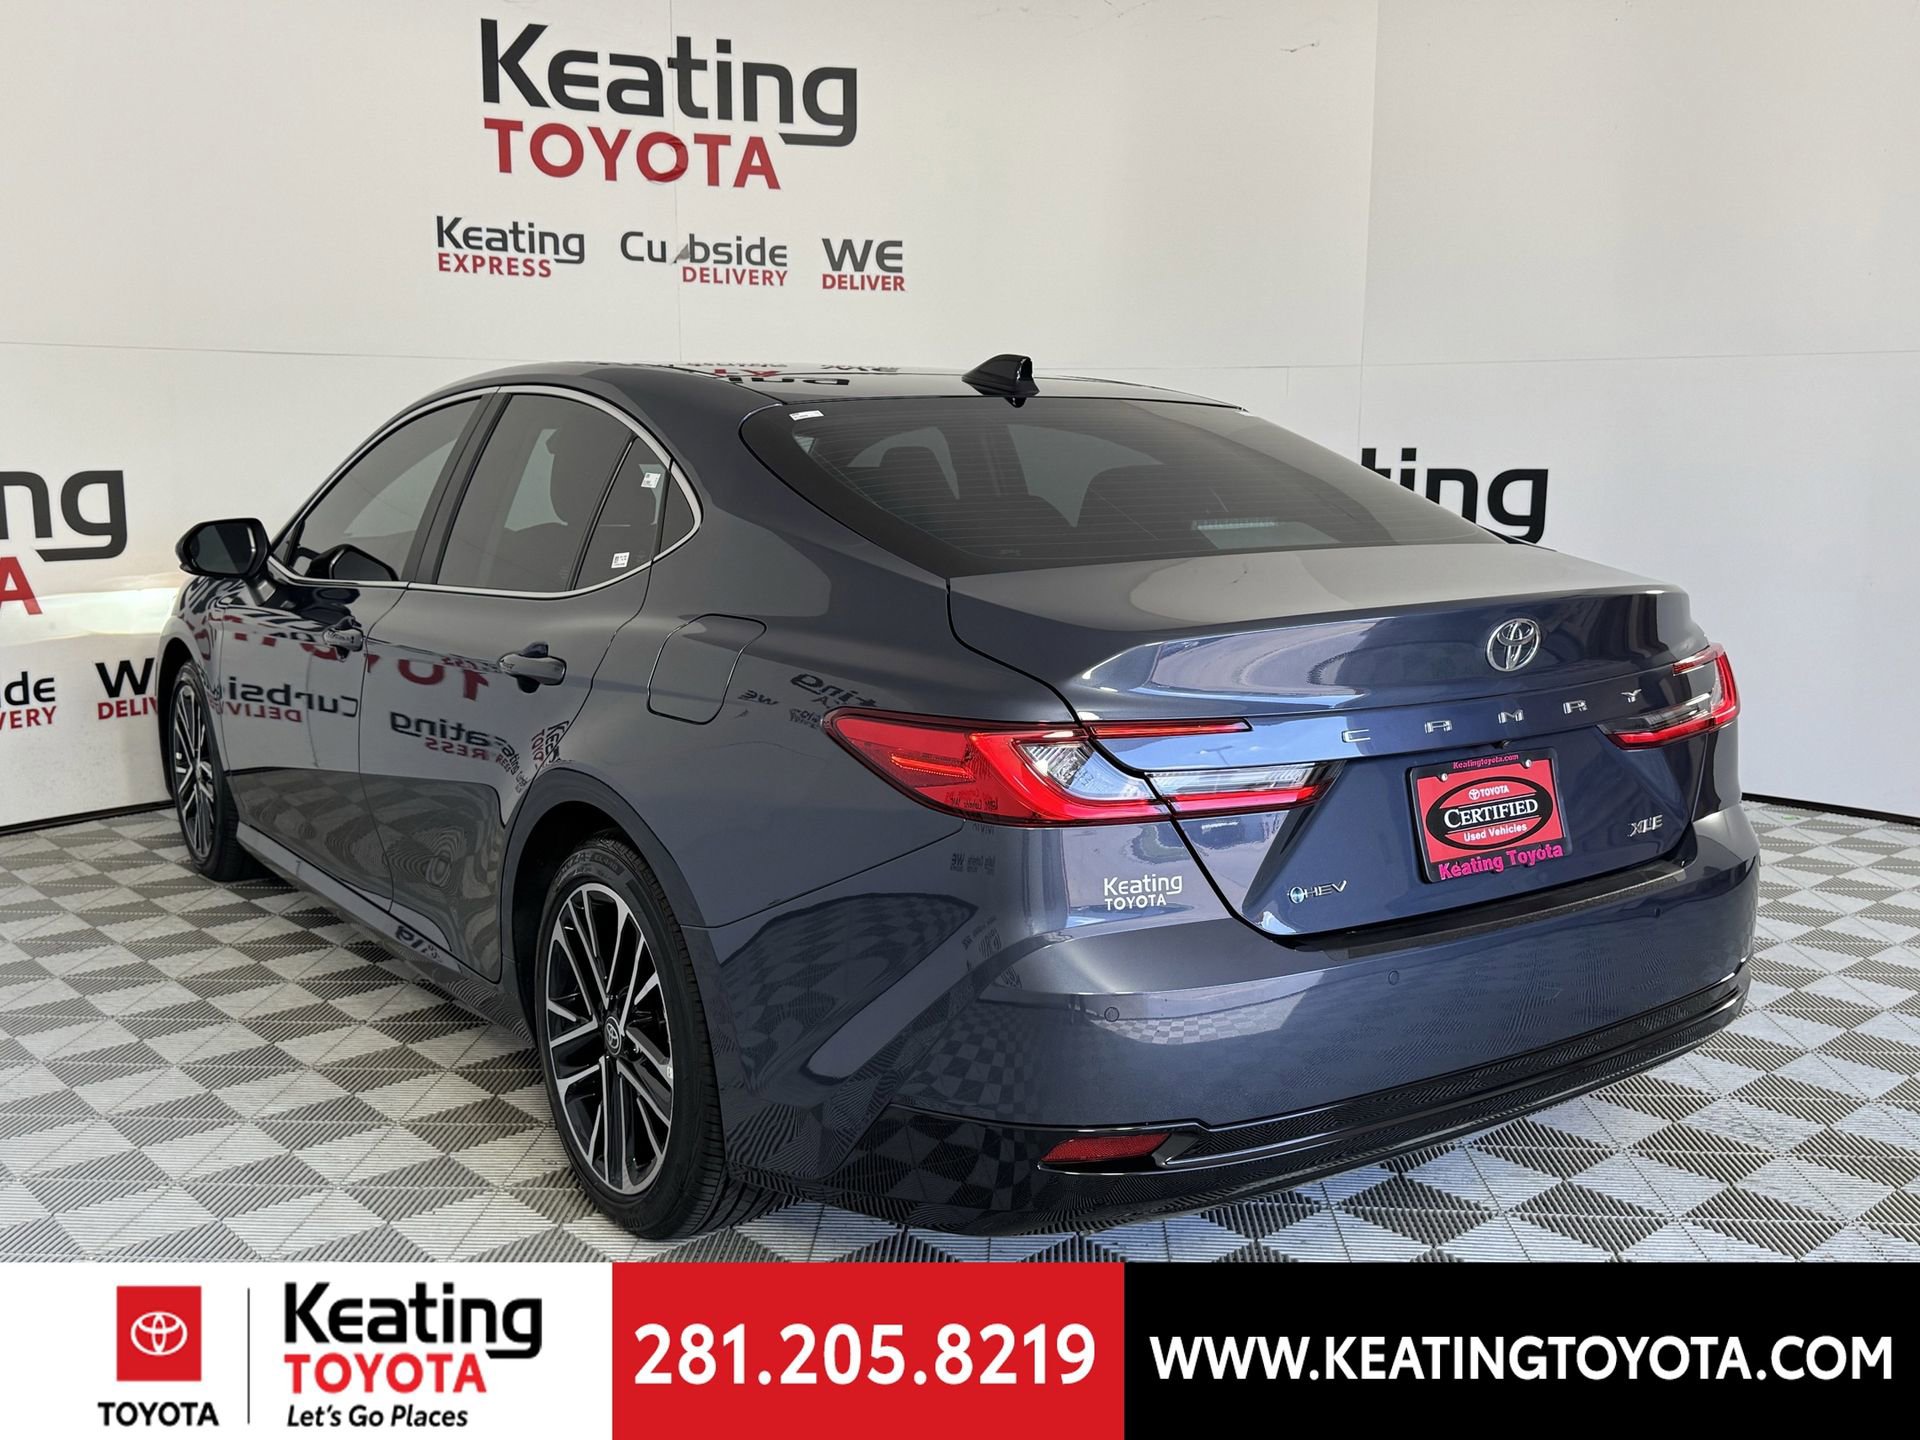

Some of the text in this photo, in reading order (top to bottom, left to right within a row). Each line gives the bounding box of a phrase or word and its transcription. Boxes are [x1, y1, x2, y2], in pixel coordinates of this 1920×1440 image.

[480, 18, 857, 147] Keating
[484, 117, 781, 190] TOYOTA
[436, 215, 585, 264] Keating
[620, 231, 788, 267] Cubside
[438, 252, 552, 278] EXPRESS
[822, 238, 903, 273] WE
[682, 266, 788, 287] DELIVERY
[821, 273, 906, 292] DELIVER
[1342, 688, 1641, 743] CAMRY
[1480, 785, 1510, 797] TOYOTA
[1444, 799, 1538, 828] CERTIFIED
[1628, 814, 1663, 837] XLE
[1463, 823, 1528, 842] Used Vehicles
[1438, 843, 1563, 880] Keating Toyota
[1104, 873, 1183, 896] Keating
[1304, 880, 1347, 898] HEV
[1105, 894, 1167, 911] TOYOTA
